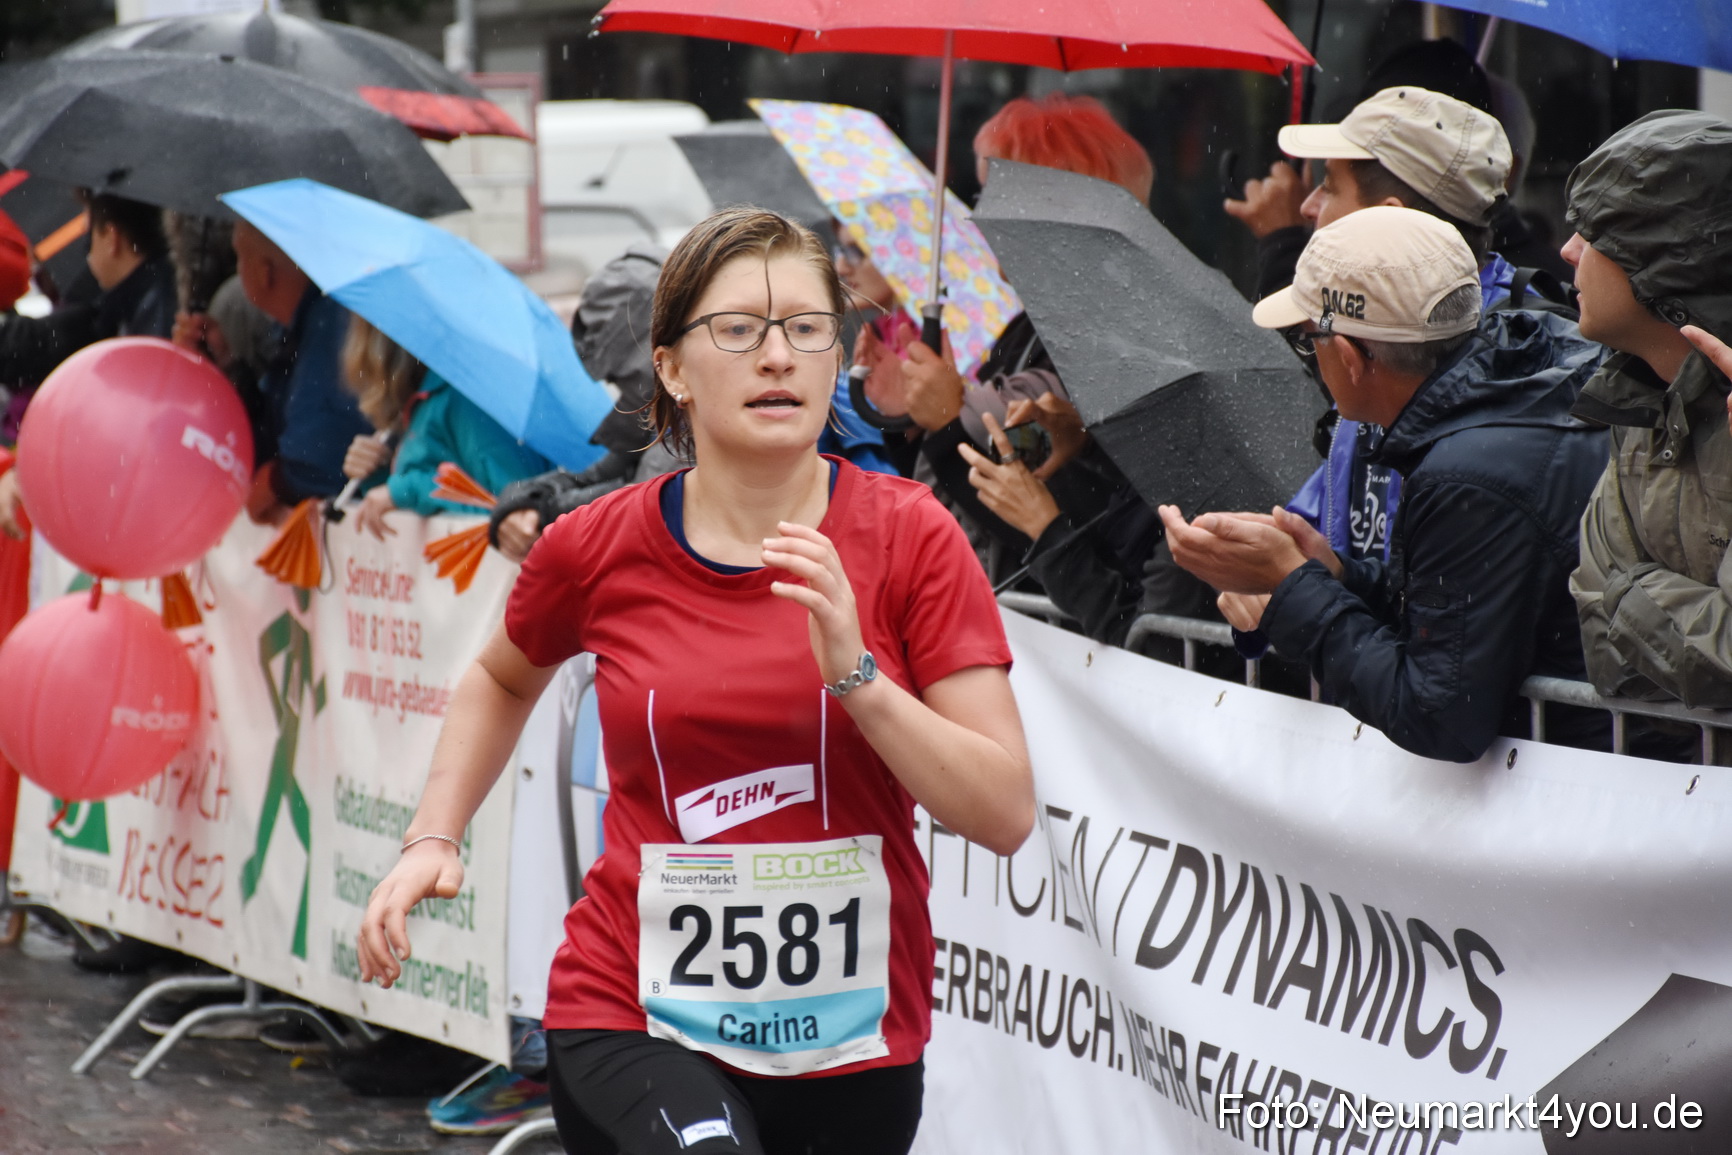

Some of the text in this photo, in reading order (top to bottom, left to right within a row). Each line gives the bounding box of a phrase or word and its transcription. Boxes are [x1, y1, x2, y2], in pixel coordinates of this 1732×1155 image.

[716, 780, 776, 818] DEHN
[661, 872, 738, 885] NeuerMarkt
[753, 847, 866, 880] BOCK
[752, 882, 790, 892] inspired
[793, 881, 804, 891] by
[806, 880, 832, 889] smart
[669, 897, 860, 989] 2581
[652, 981, 660, 994] B
[932, 936, 1123, 1073] ERBRAUCH.
[718, 1012, 819, 1045] Carina
